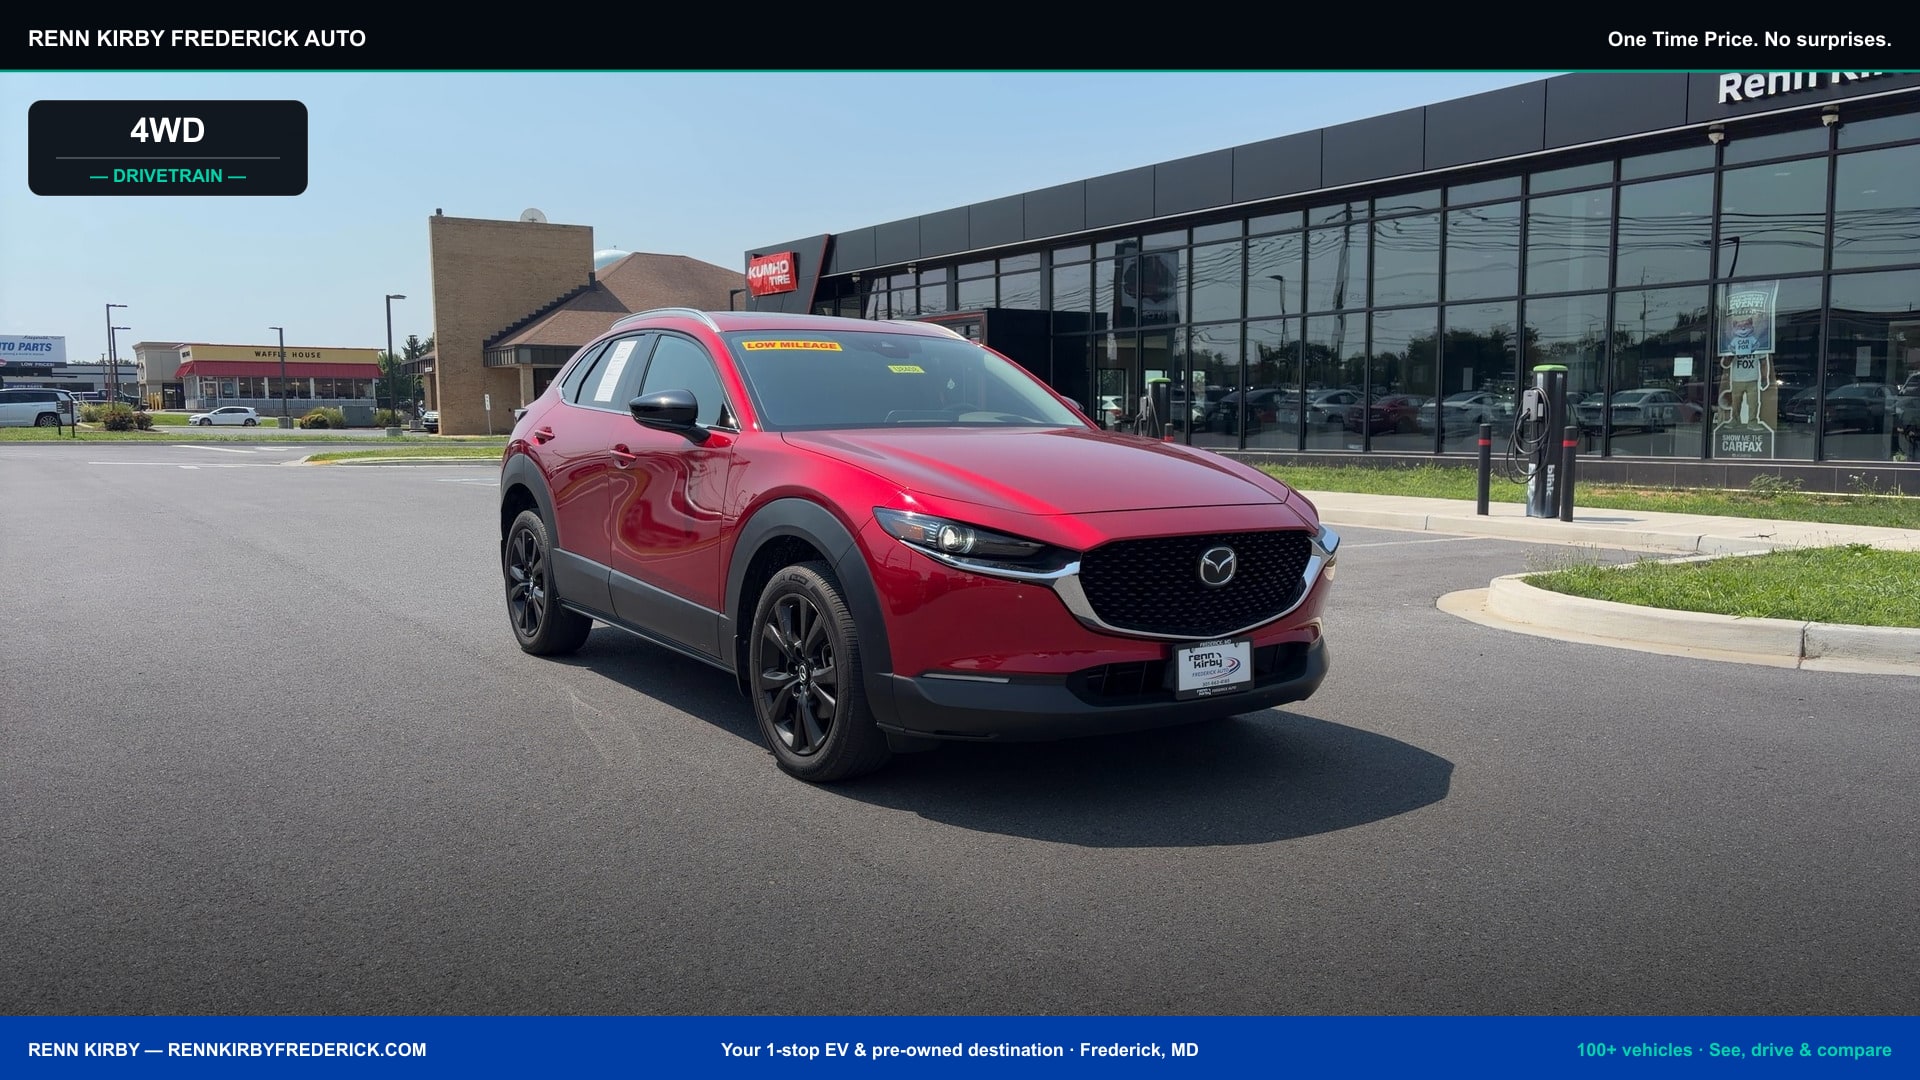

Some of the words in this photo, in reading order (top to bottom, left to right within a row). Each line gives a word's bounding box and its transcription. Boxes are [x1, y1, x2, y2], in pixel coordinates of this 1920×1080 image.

[748, 259, 789, 279] KUMHO
[769, 274, 791, 286] TIRE
[18, 342, 53, 351] PARTS
[292, 351, 321, 359] HOUSE
[1737, 360, 1754, 369] FOX
[1722, 441, 1763, 452] CARFAX
[1189, 652, 1215, 661] renn
[1194, 659, 1222, 669] kirby
[1192, 669, 1216, 677] FREDERICK
